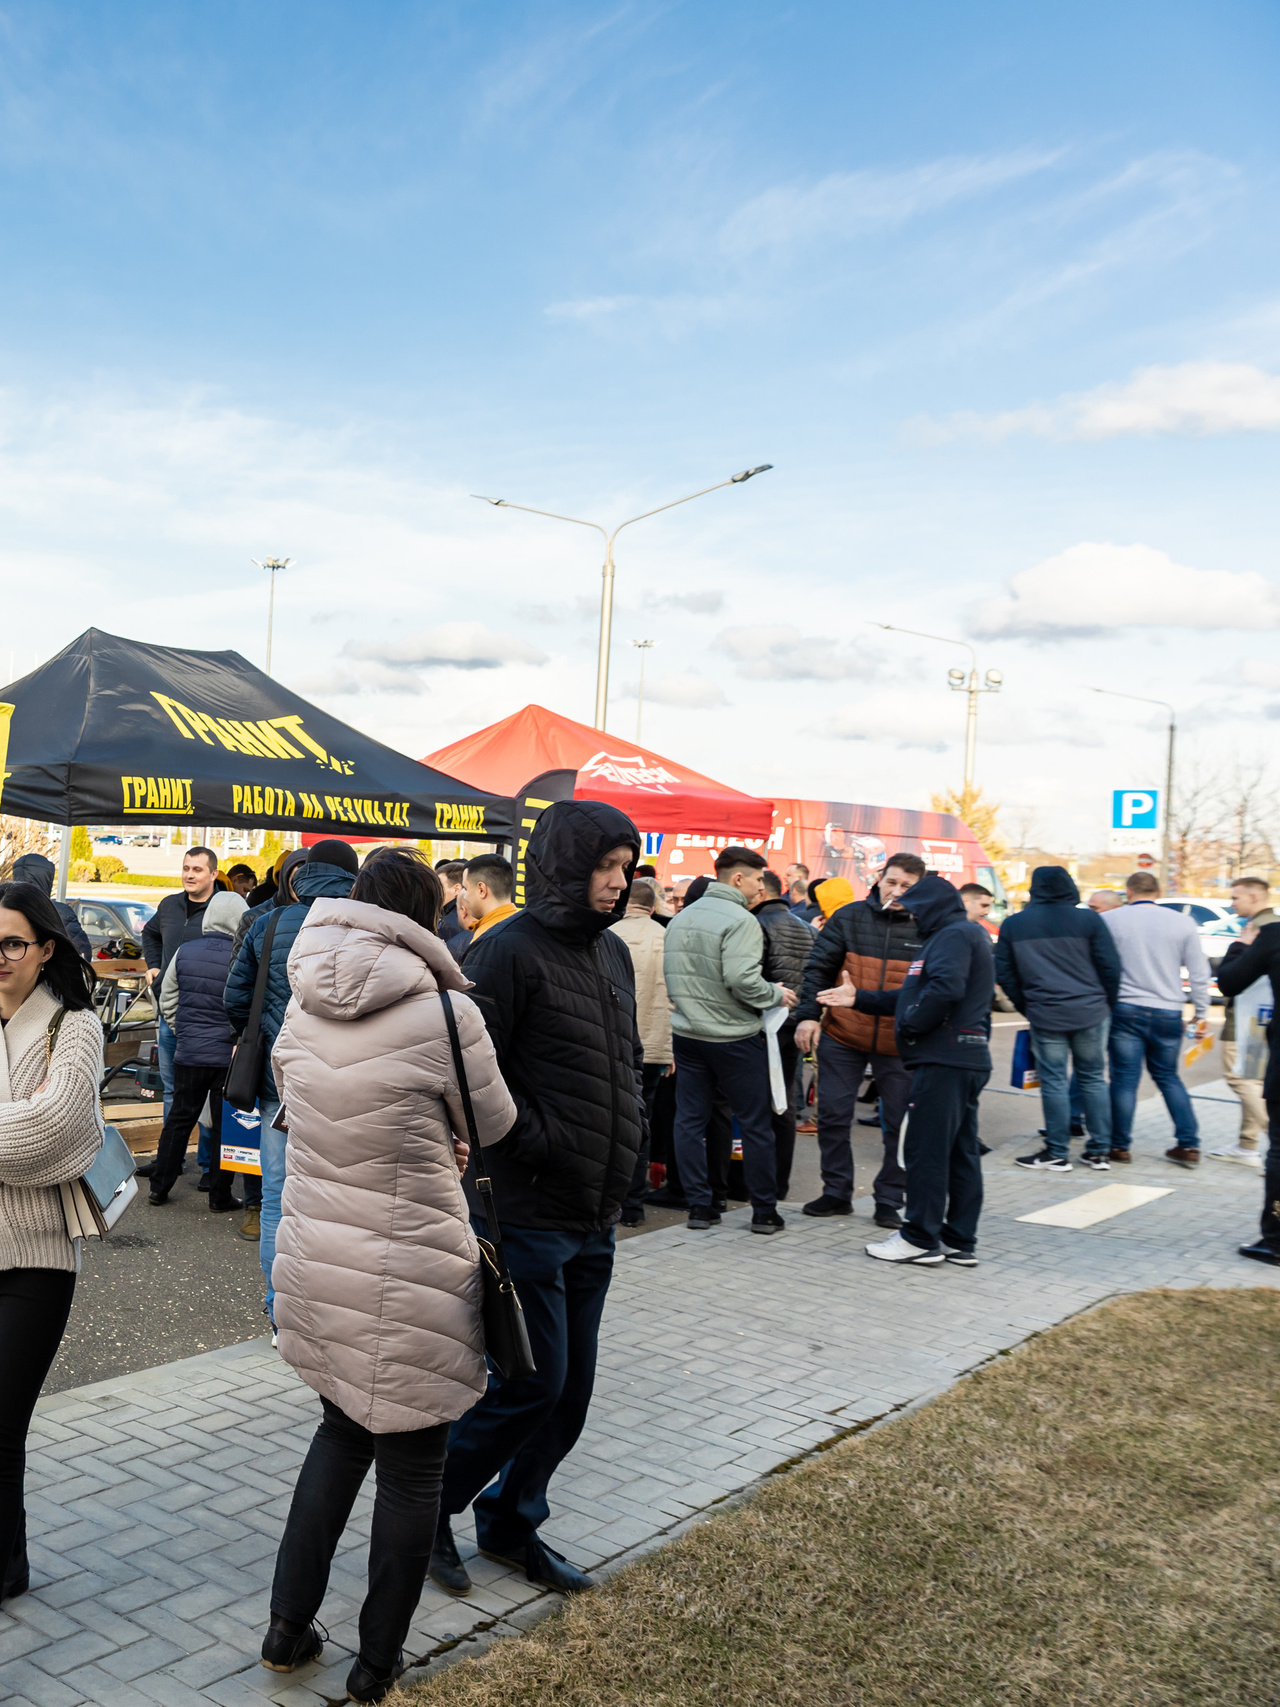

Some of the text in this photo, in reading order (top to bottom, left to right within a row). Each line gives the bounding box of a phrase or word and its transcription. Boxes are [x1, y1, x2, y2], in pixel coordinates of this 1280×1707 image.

[149, 691, 329, 764] ГРАНИТ
[121, 776, 193, 809] ГРАНИТ
[232, 785, 410, 827] РАБОТА НА РЕЗУЛЬТАТ
[1121, 792, 1154, 826] P
[435, 803, 486, 831] ГРАНИТ
